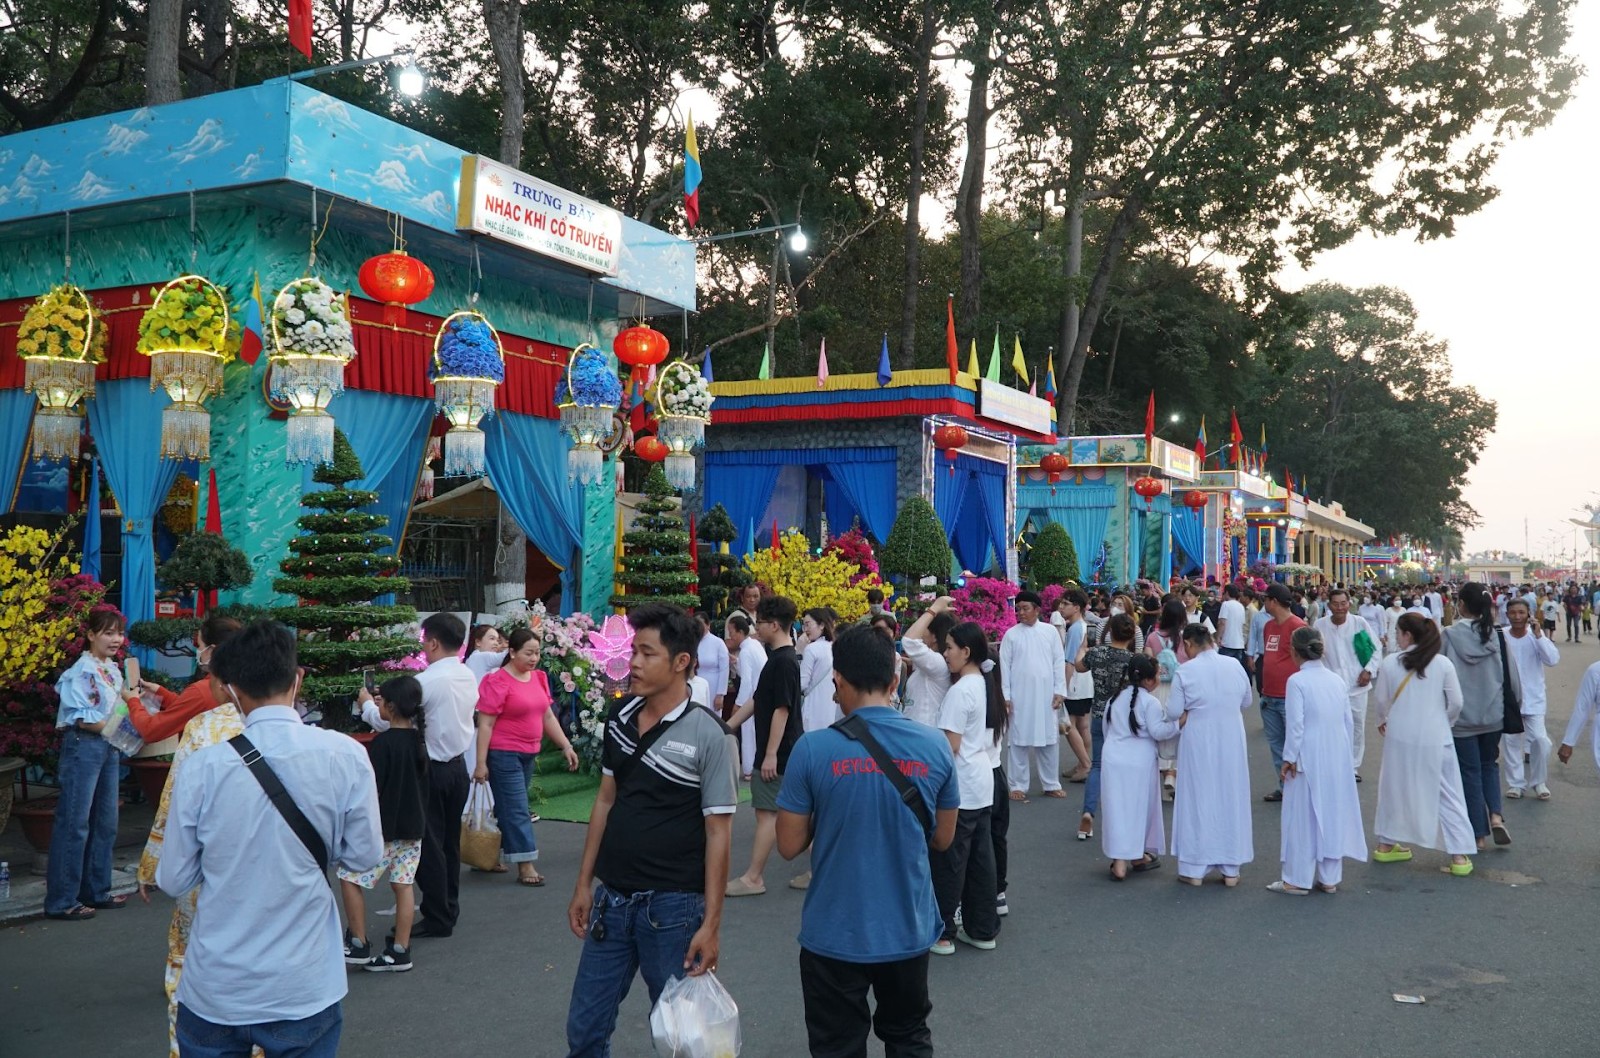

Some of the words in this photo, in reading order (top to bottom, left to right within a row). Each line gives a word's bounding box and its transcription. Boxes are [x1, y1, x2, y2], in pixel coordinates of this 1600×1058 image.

[485, 194, 521, 222] NHẠC
[524, 208, 547, 231] KHÍ
[550, 215, 568, 237] CỔ
[513, 181, 562, 210] TRƯNG
[568, 203, 595, 222] BÀY
[666, 741, 686, 749] PUMA
